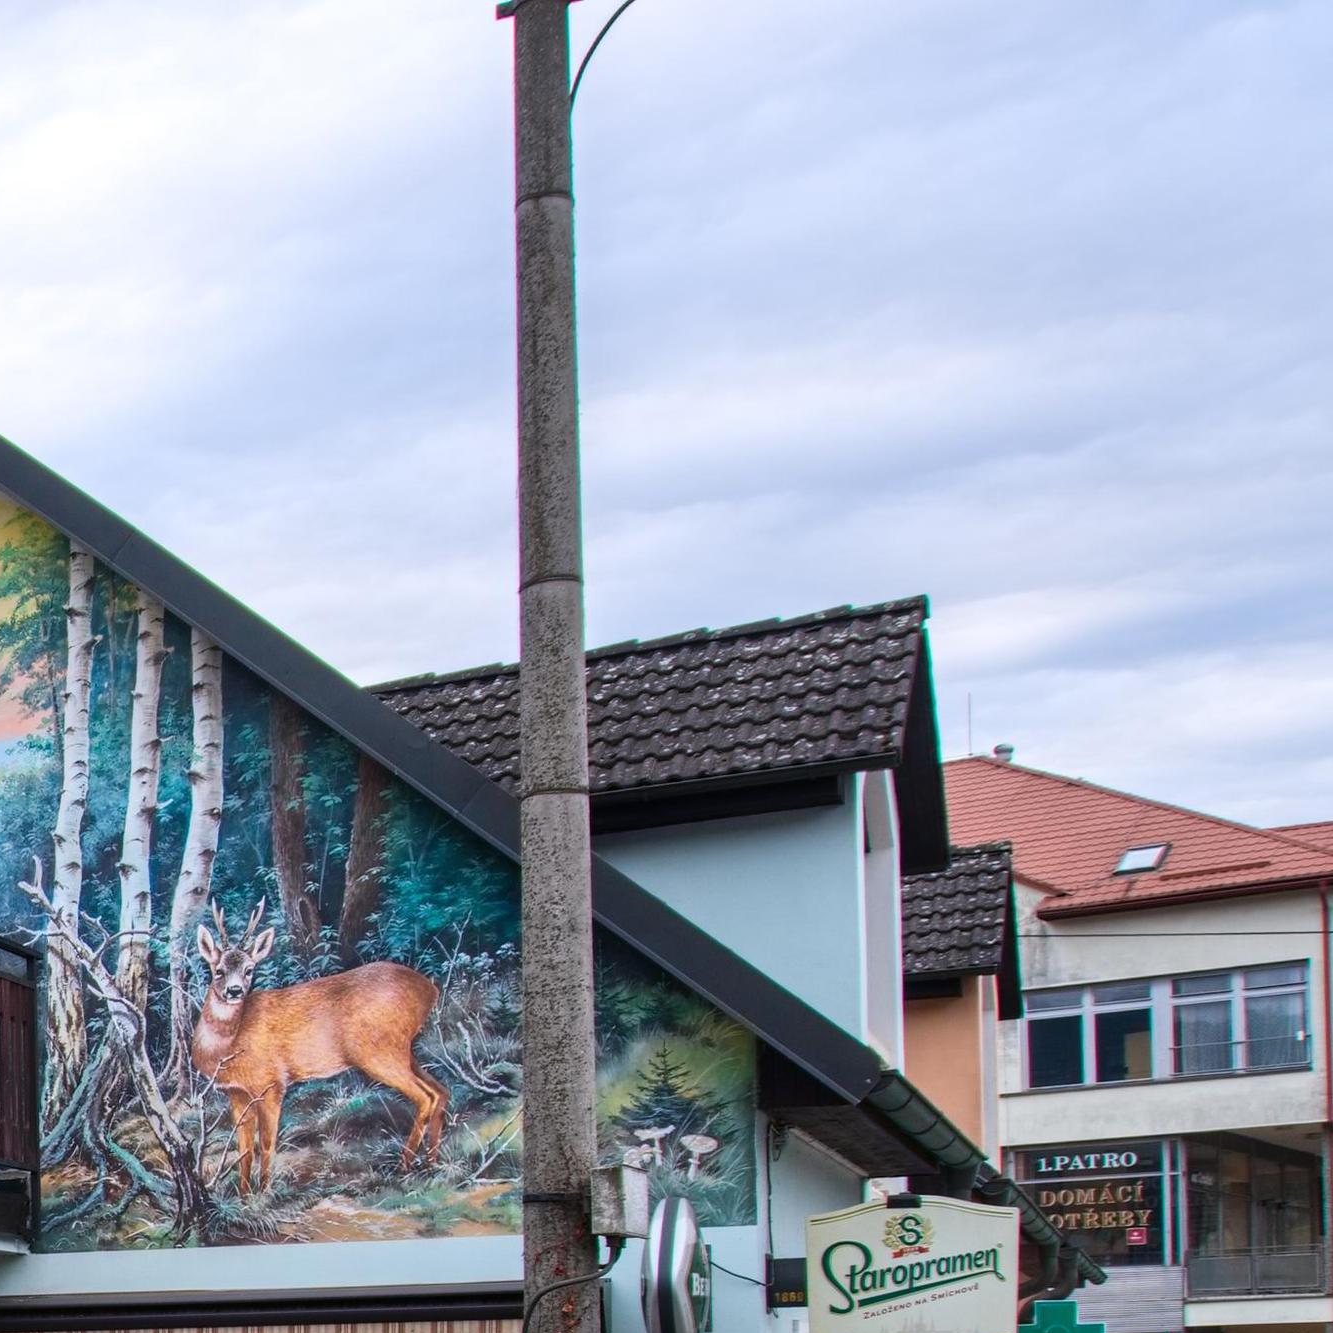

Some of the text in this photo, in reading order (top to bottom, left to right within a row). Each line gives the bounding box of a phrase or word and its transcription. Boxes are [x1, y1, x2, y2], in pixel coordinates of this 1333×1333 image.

[1041, 1180, 1144, 1207] DOMÁCÍ
[1049, 1208, 1152, 1229] OTŘEBY
[822, 1240, 1005, 1313] Staropramen
[863, 1302, 913, 1319] ZALOŽENO
[914, 1298, 927, 1306] NA
